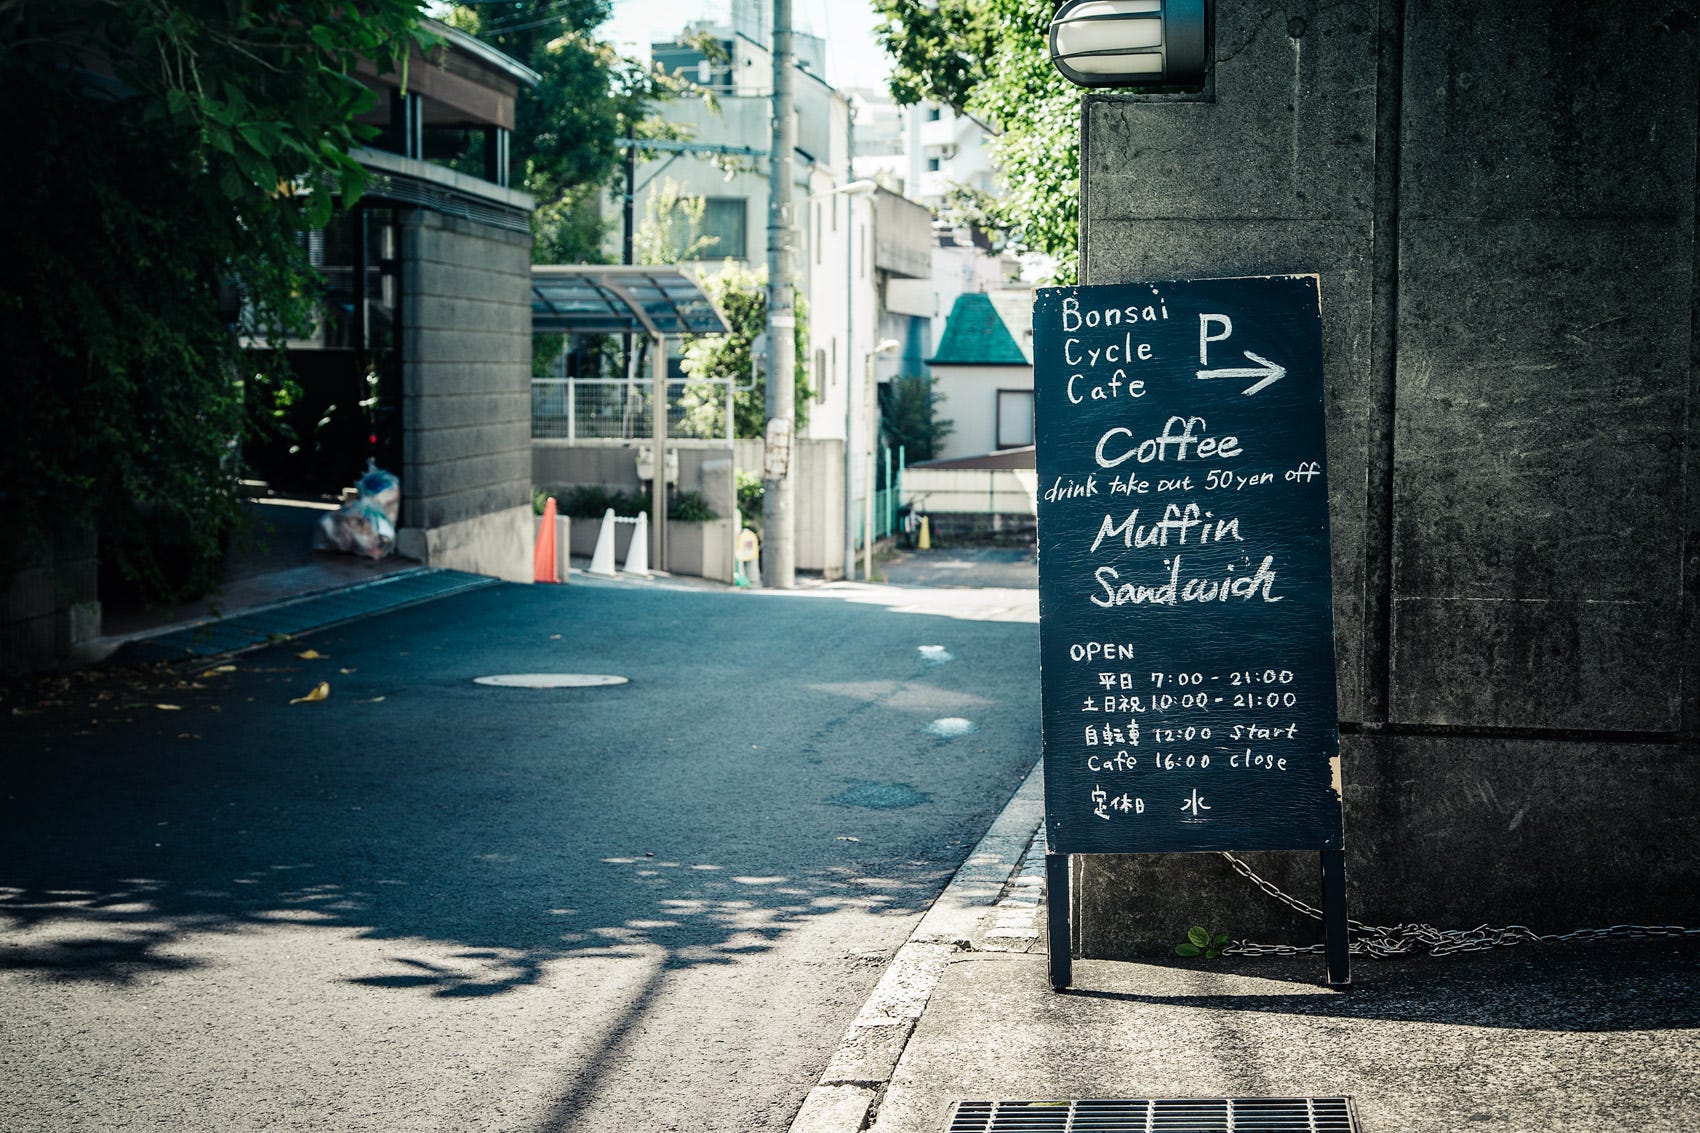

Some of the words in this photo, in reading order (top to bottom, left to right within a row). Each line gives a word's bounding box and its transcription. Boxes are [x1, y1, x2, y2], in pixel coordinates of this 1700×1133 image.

[1062, 297, 1169, 332] Bonsai
[1064, 331, 1153, 367] Cycle
[1199, 313, 1232, 365] P
[1067, 369, 1147, 404] Cafe
[1095, 416, 1243, 468] Coffee
[1044, 473, 1098, 503] drink
[1108, 472, 1150, 496] take
[1157, 475, 1195, 492] out
[1285, 461, 1321, 483] off
[1090, 503, 1244, 554] Muffin
[1090, 554, 1284, 608] Sandwich
[1069, 641, 1135, 664] OPEN
[1098, 672, 1133, 690] 平日
[1081, 694, 1146, 713] 土日祝
[1085, 719, 1140, 747] 自転車
[1153, 726, 1212, 742] 12:00
[1087, 751, 1137, 772] Cafe
[1156, 752, 1210, 769] 16:00
[1091, 784, 1145, 820] 定休日
[1179, 788, 1212, 816] 水
